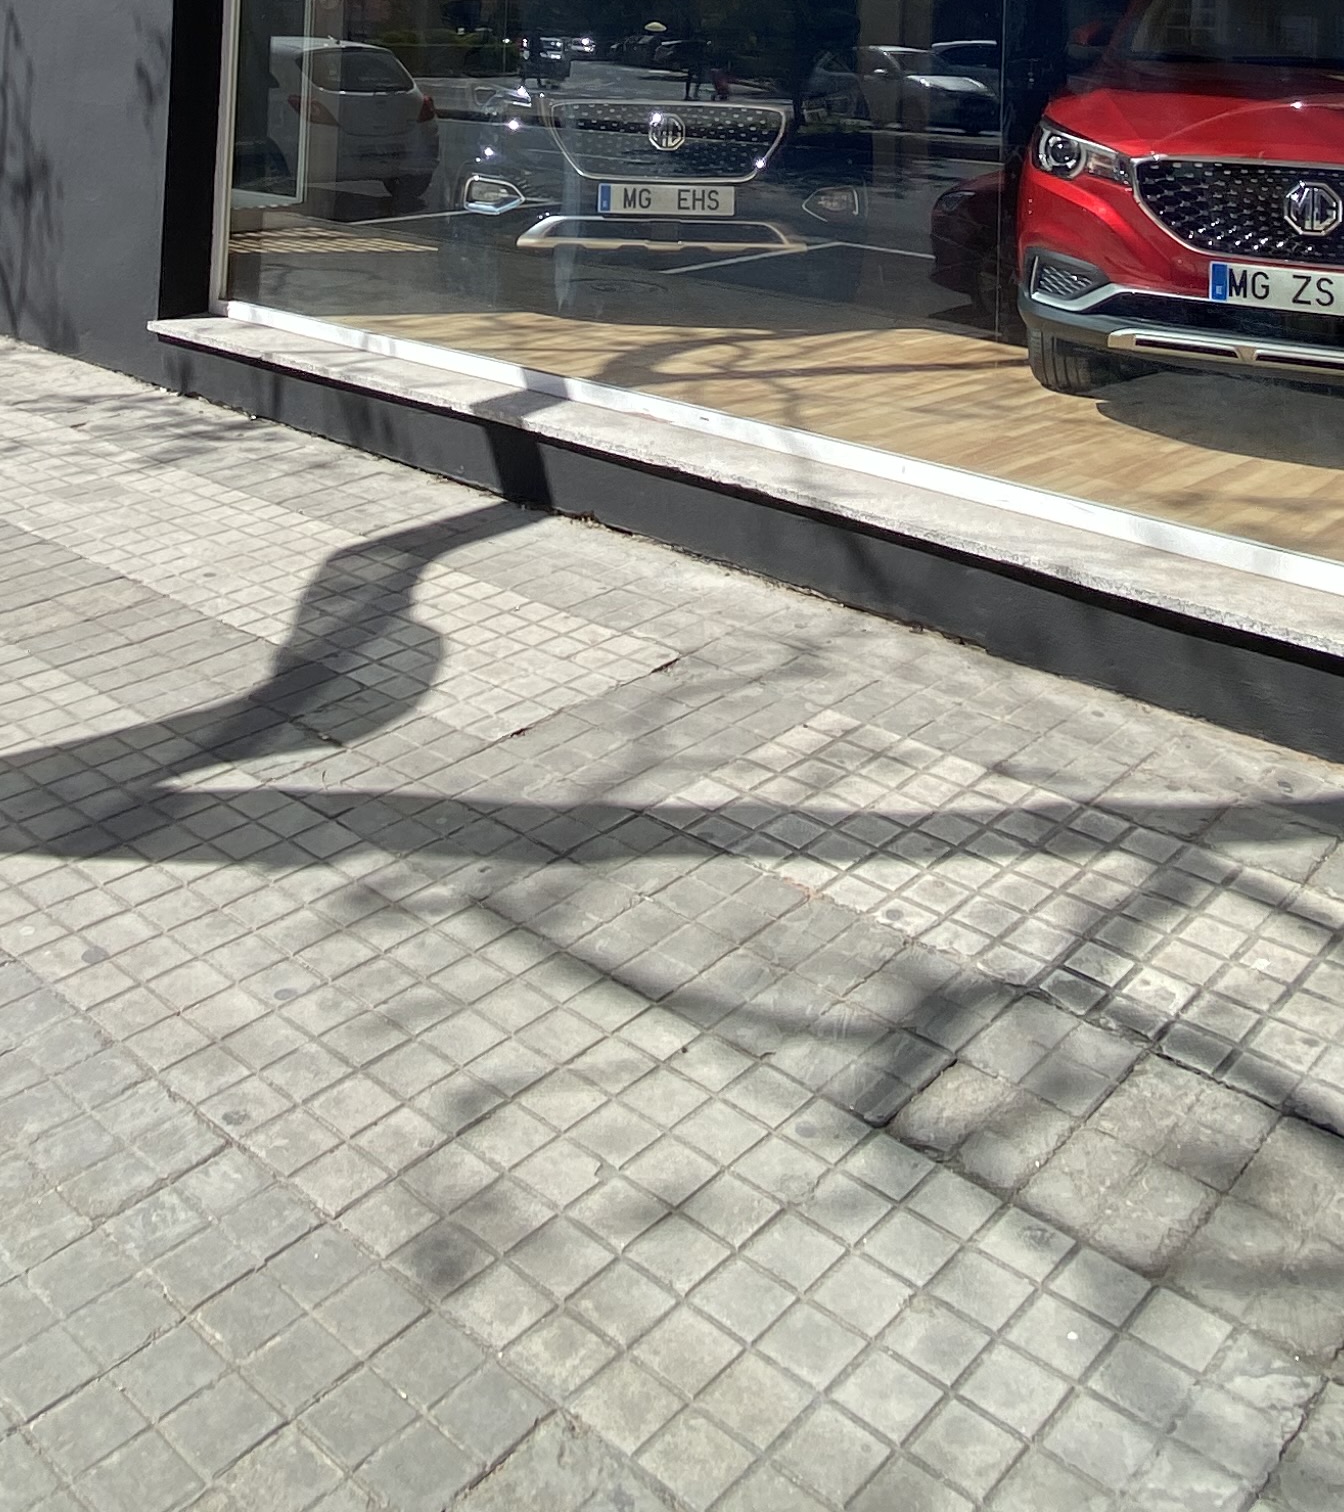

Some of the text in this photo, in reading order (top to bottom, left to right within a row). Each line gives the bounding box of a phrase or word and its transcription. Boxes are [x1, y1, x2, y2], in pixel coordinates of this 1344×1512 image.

[623, 187, 720, 211] MG EHS
[1228, 268, 1270, 300] MG
[1292, 274, 1334, 307] ZS
